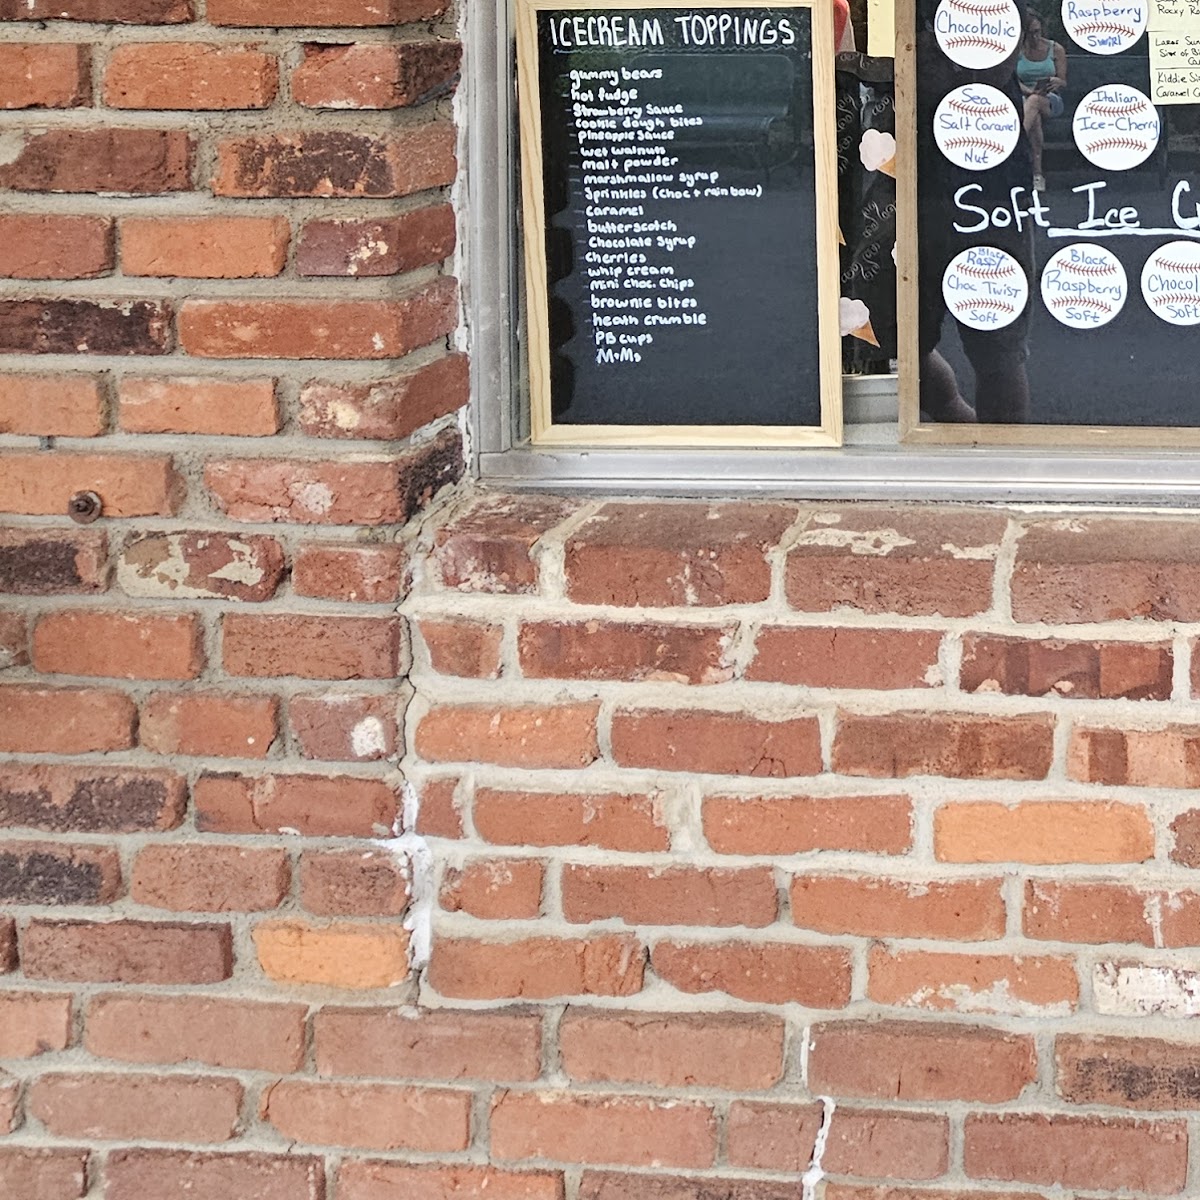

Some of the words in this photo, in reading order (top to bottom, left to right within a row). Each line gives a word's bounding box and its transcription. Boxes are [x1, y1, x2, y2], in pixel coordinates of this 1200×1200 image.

[1067, 1, 1142, 23] Raspberry
[549, 15, 665, 46] ICECREAM
[674, 13, 795, 45] TOPPINGS
[936, 9, 1017, 38] Chocoholic
[1180, 48, 1189, 57] of
[569, 69, 619, 90] gummy
[621, 67, 663, 80] bears
[1157, 71, 1187, 84] Kiddie
[571, 87, 594, 102] hot
[598, 87, 638, 106] fudge
[961, 88, 991, 105] Sea
[1091, 90, 1139, 103] Italian
[1156, 86, 1189, 98] Caramel
[622, 116, 665, 132] dough
[670, 116, 703, 127] bites
[939, 113, 971, 131] Salt
[975, 116, 1017, 132] Caramel
[577, 129, 636, 145] pineapple
[580, 146, 608, 157] wet
[610, 145, 666, 155] walnuts
[964, 147, 989, 164] Nut
[623, 155, 679, 172] powder
[583, 173, 674, 185] marshmallow
[952, 183, 1051, 233] Soft
[1072, 181, 1140, 229] Ice
[587, 219, 678, 234] butterscotch
[1070, 249, 1108, 266] Black
[588, 266, 622, 278] whip
[627, 265, 674, 276] cream
[947, 274, 977, 292] Choc
[1044, 269, 1122, 301] Raspberry
[591, 293, 652, 308] brownie
[657, 296, 697, 308] bites
[592, 312, 638, 326] heath
[644, 313, 707, 326] crumble
[969, 310, 999, 324] Soft
[1065, 307, 1101, 323] Soft
[1166, 304, 1200, 318] Soft
[595, 330, 616, 345] PB
[619, 333, 653, 346] cups
